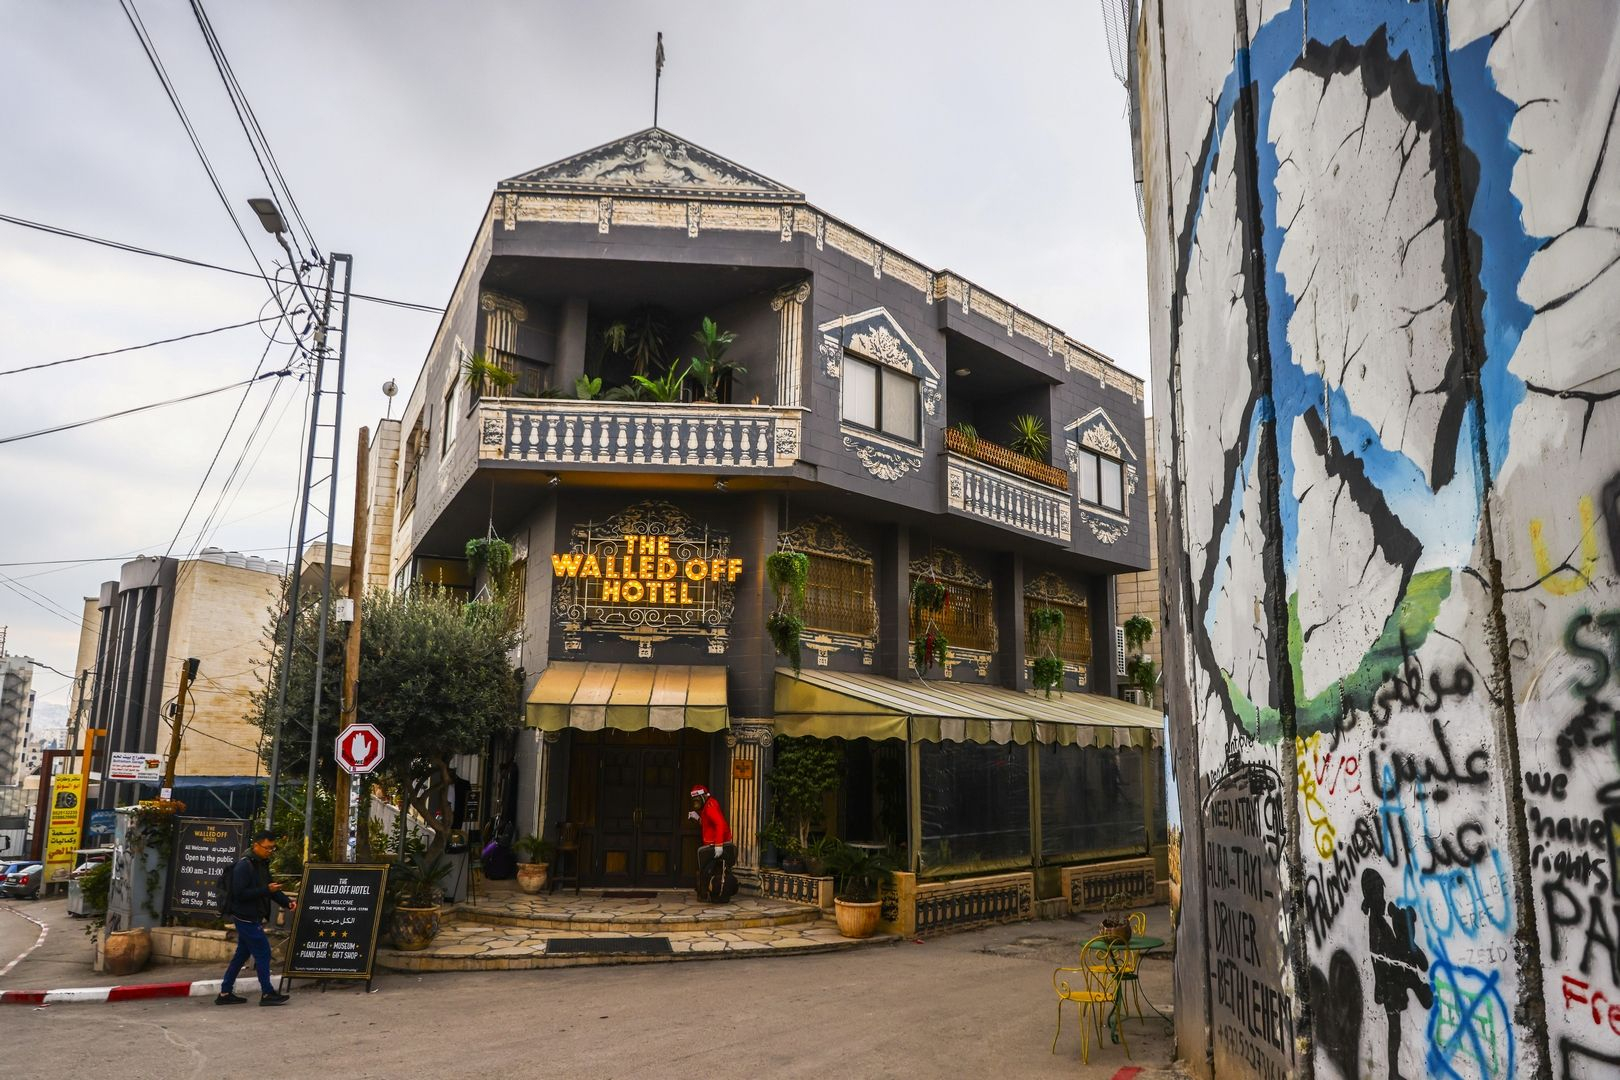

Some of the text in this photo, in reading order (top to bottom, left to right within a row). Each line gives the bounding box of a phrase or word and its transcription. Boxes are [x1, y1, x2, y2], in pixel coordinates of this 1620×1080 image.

[624, 535, 670, 556] THE
[551, 553, 743, 582] WALLED OFF
[602, 579, 693, 604] HOTEL
[1525, 771, 1568, 802] we
[1211, 799, 1234, 831] NEED
[1238, 796, 1262, 838] TAXI
[1529, 806, 1607, 846] have
[185, 853, 199, 862] Open
[206, 854, 216, 862] the
[216, 855, 234, 864] public
[180, 865, 194, 874] 8:00
[193, 867, 204, 875] am
[208, 867, 224, 876] 11:00
[181, 889, 200, 898] Gallery
[313, 884, 371, 894] WALLED OFF HOTEL
[180, 897, 190, 905] Gift
[190, 898, 204, 907] Shop
[339, 917, 356, 926] الكل
[1213, 899, 1262, 968] DRIVER
[316, 950, 327, 958] BAR
[344, 951, 359, 960] SHOP
